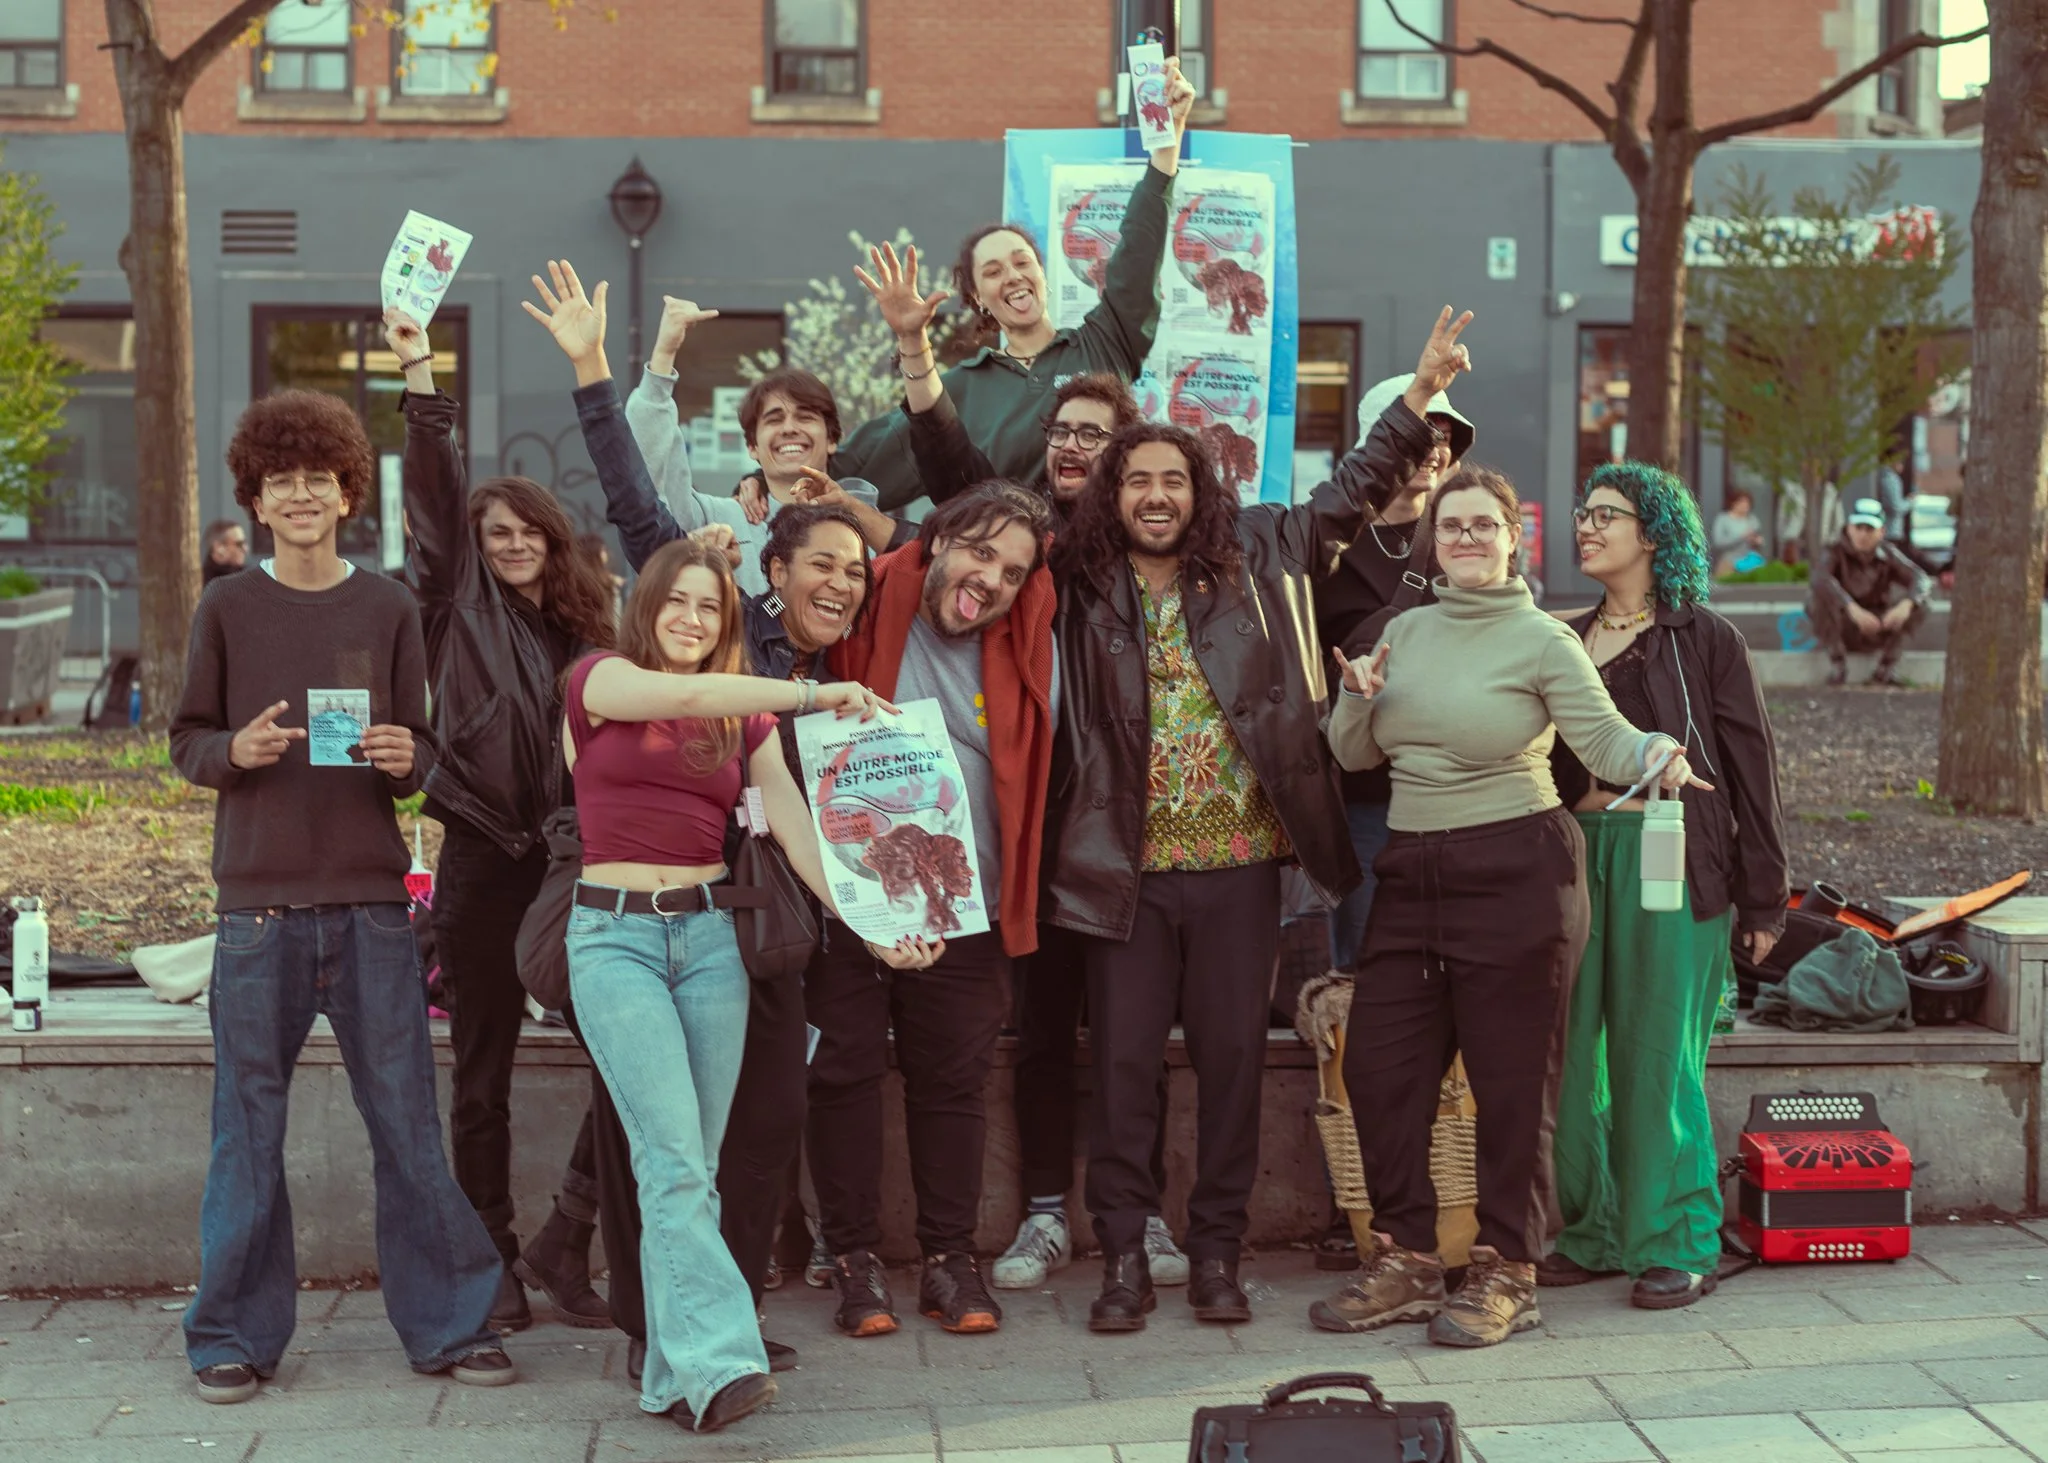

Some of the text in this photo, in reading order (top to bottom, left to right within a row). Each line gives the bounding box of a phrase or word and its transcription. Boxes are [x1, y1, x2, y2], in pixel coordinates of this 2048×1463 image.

[1195, 207, 1226, 216] AUTRE
[1227, 208, 1262, 218] MONDE
[1174, 370, 1262, 383] UN AUTRE MONDE
[1184, 380, 1251, 392] EST POSSIBLE
[817, 749, 944, 779] UN AUTRE MONDE
[834, 762, 936, 789] EST POSSIBLE
